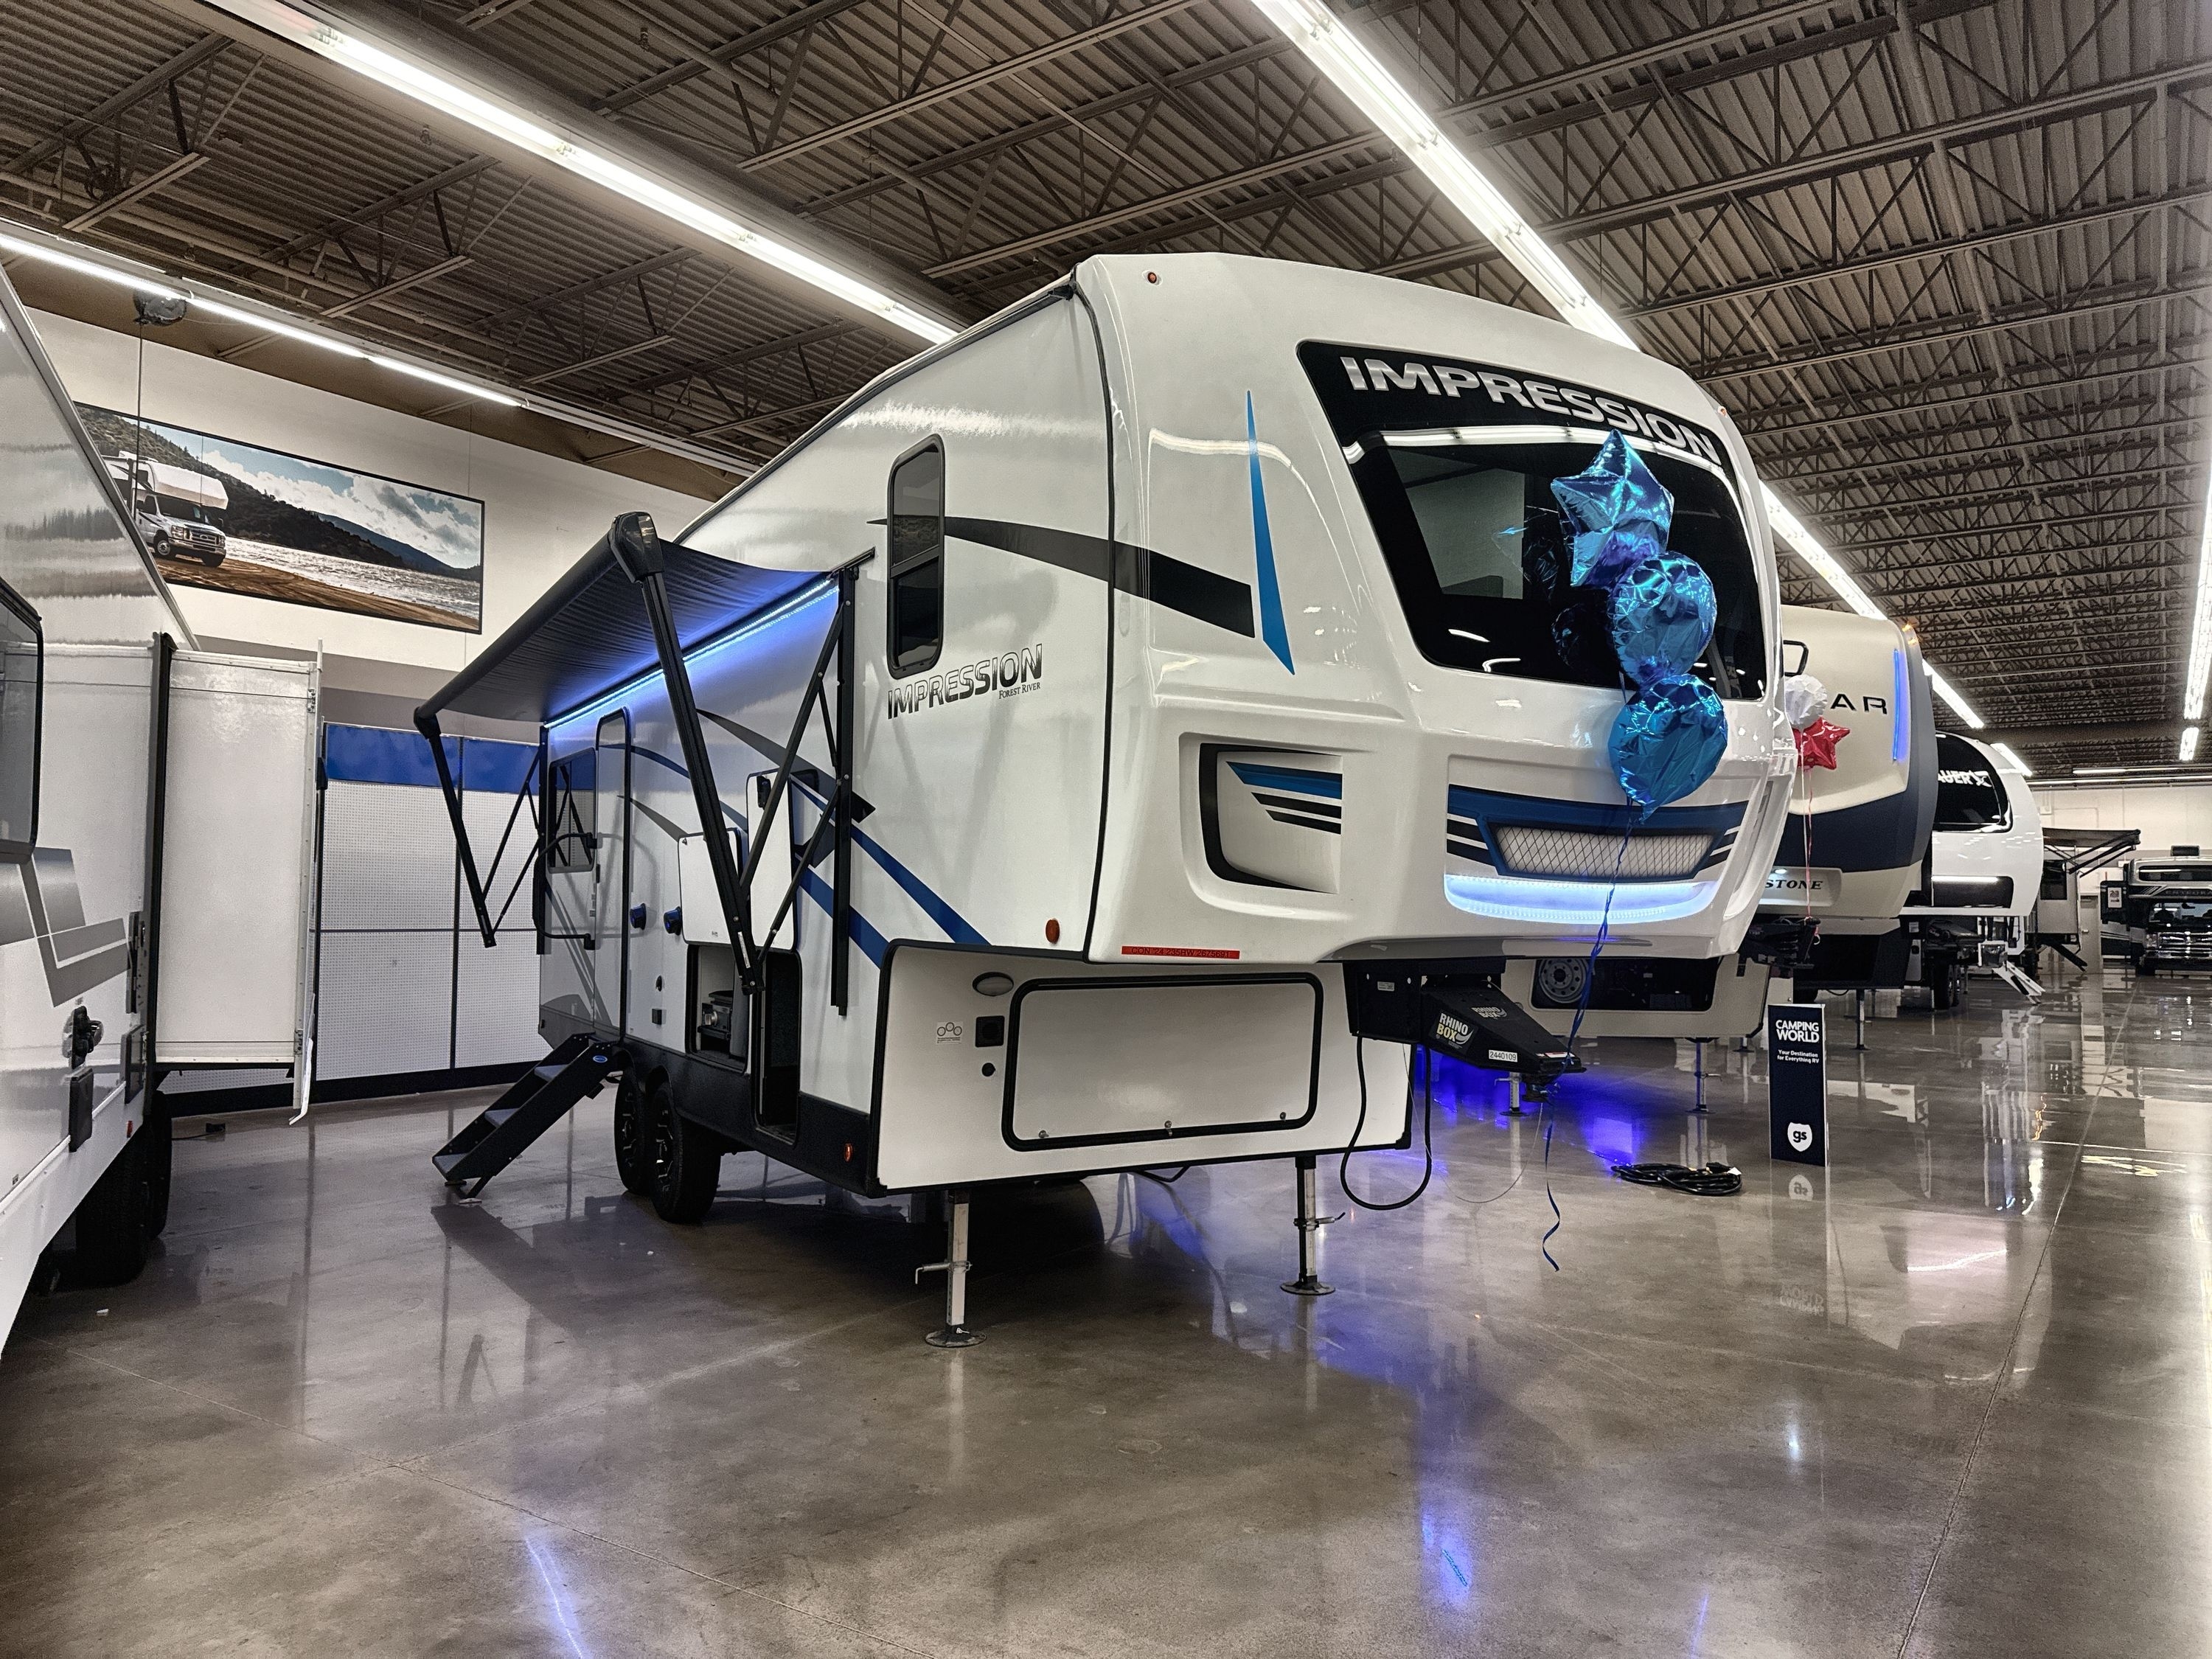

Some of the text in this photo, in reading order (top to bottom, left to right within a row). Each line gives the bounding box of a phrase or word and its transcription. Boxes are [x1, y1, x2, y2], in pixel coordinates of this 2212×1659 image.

[1340, 356, 1723, 467] IMPRESSION
[887, 643, 1043, 720] IMPRESSION
[1131, 947, 1150, 955] CON
[1439, 1012, 1469, 1035] RHINO
[1775, 1019, 1820, 1032] CAMPING
[1436, 1023, 1458, 1043] BOX
[1776, 1029, 1820, 1043] WORLD
[1489, 1051, 1517, 1061] 2440109
[1784, 1055, 1812, 1064] Everything
[1790, 1050, 1818, 1058] Destination
[1792, 1130, 1807, 1143] gs
